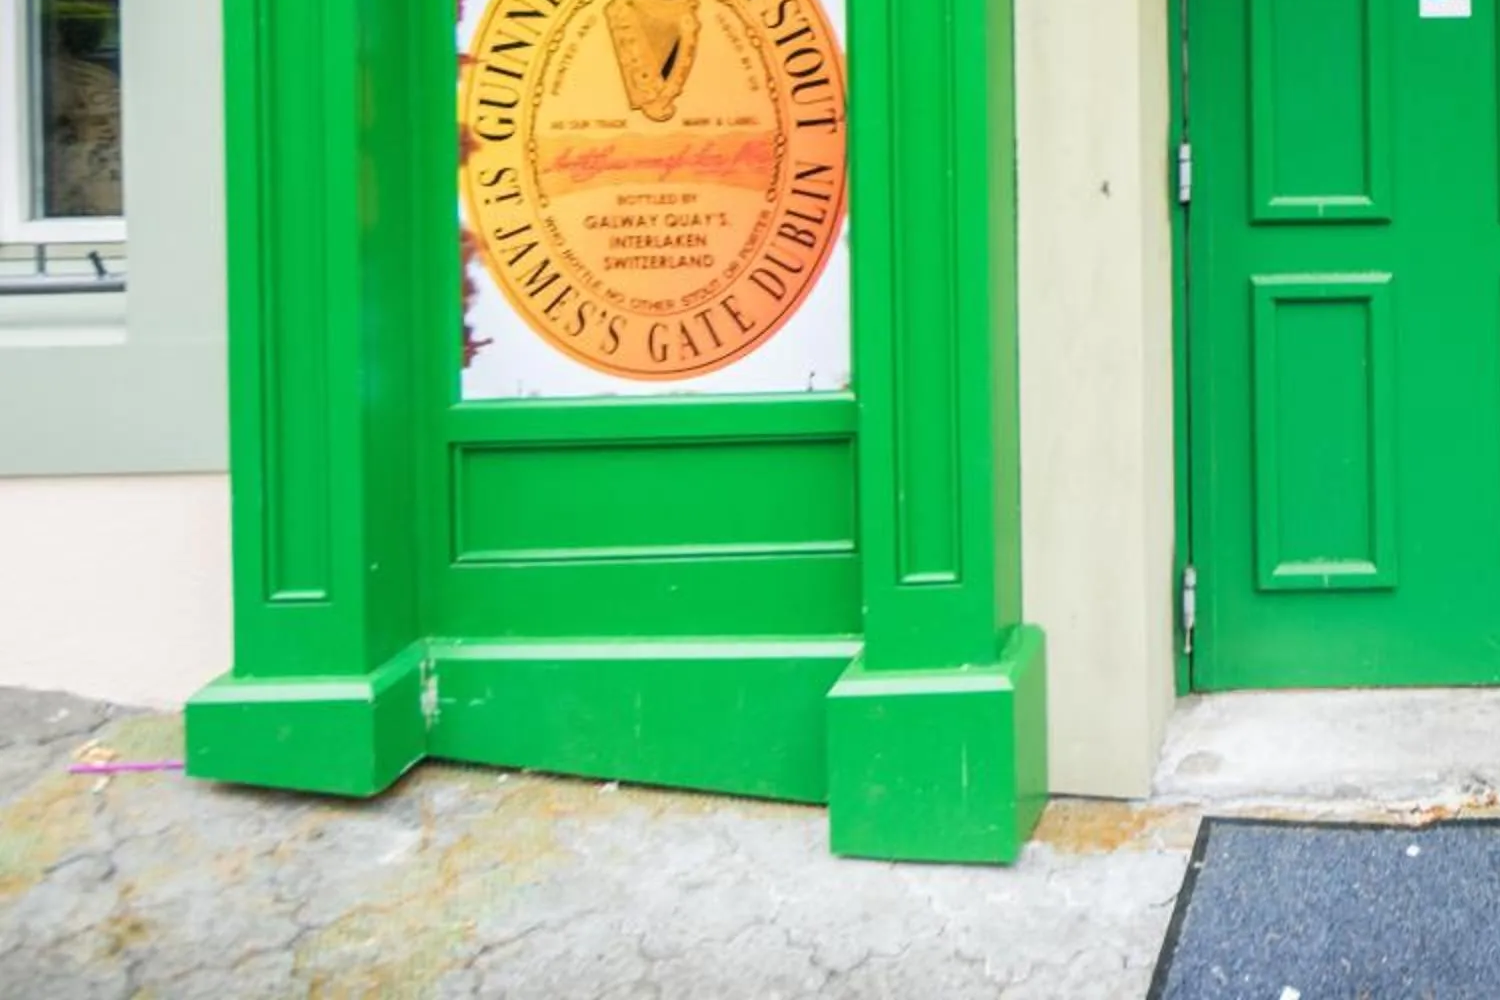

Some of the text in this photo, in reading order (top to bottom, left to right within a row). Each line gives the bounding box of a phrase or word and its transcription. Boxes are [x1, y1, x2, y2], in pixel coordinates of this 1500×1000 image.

[616, 193, 698, 206] BOTTLED BY
[583, 213, 659, 230] GALWAY
[609, 234, 708, 250] INTERLAKEN
[494, 222, 628, 356] JAMES'S
[647, 294, 757, 364] GATE
[748, 160, 836, 302] DUBLIN
[603, 254, 715, 272] SWITZERLAND
